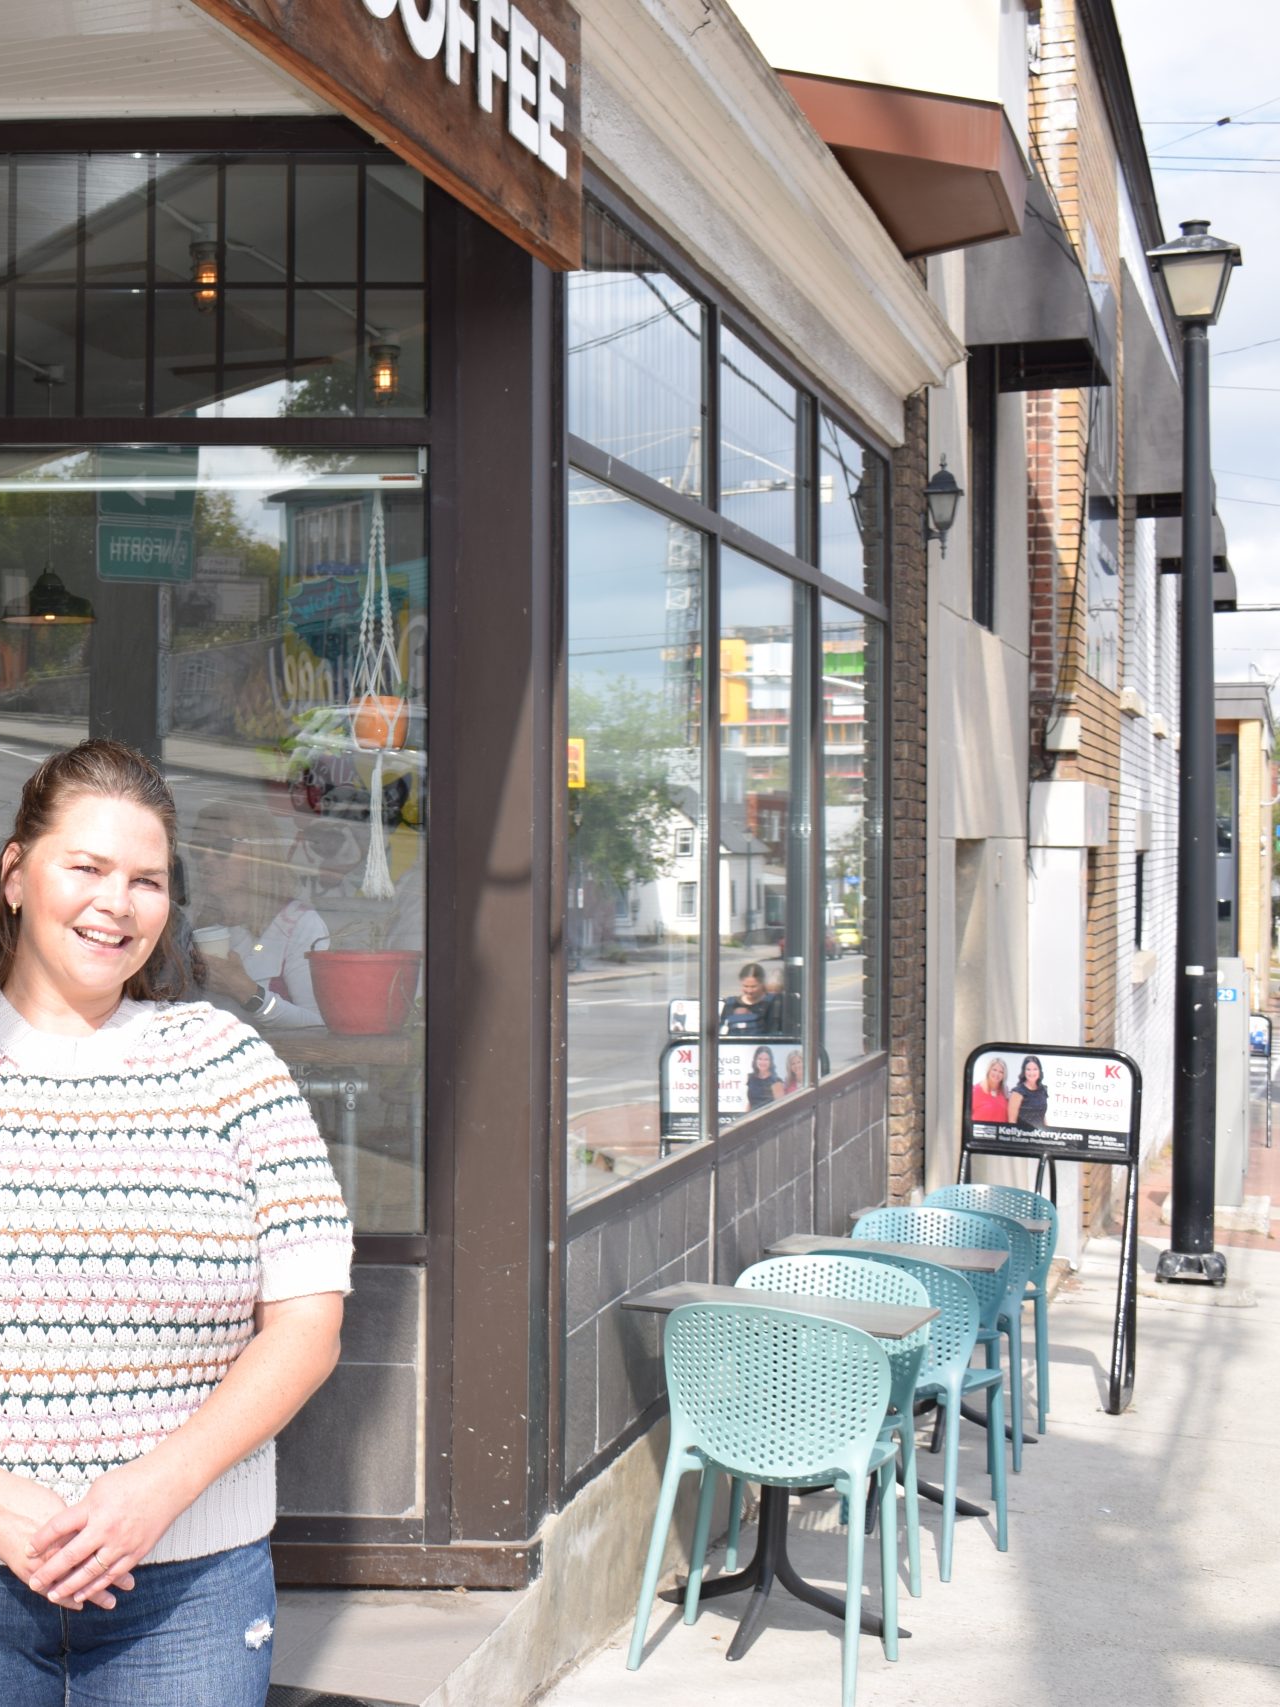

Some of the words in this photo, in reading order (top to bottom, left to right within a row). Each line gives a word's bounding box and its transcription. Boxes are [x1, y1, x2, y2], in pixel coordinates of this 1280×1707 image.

[1055, 1067, 1096, 1080] Buying
[1071, 1079, 1116, 1093] Selling?
[1055, 1094, 1089, 1105] Think
